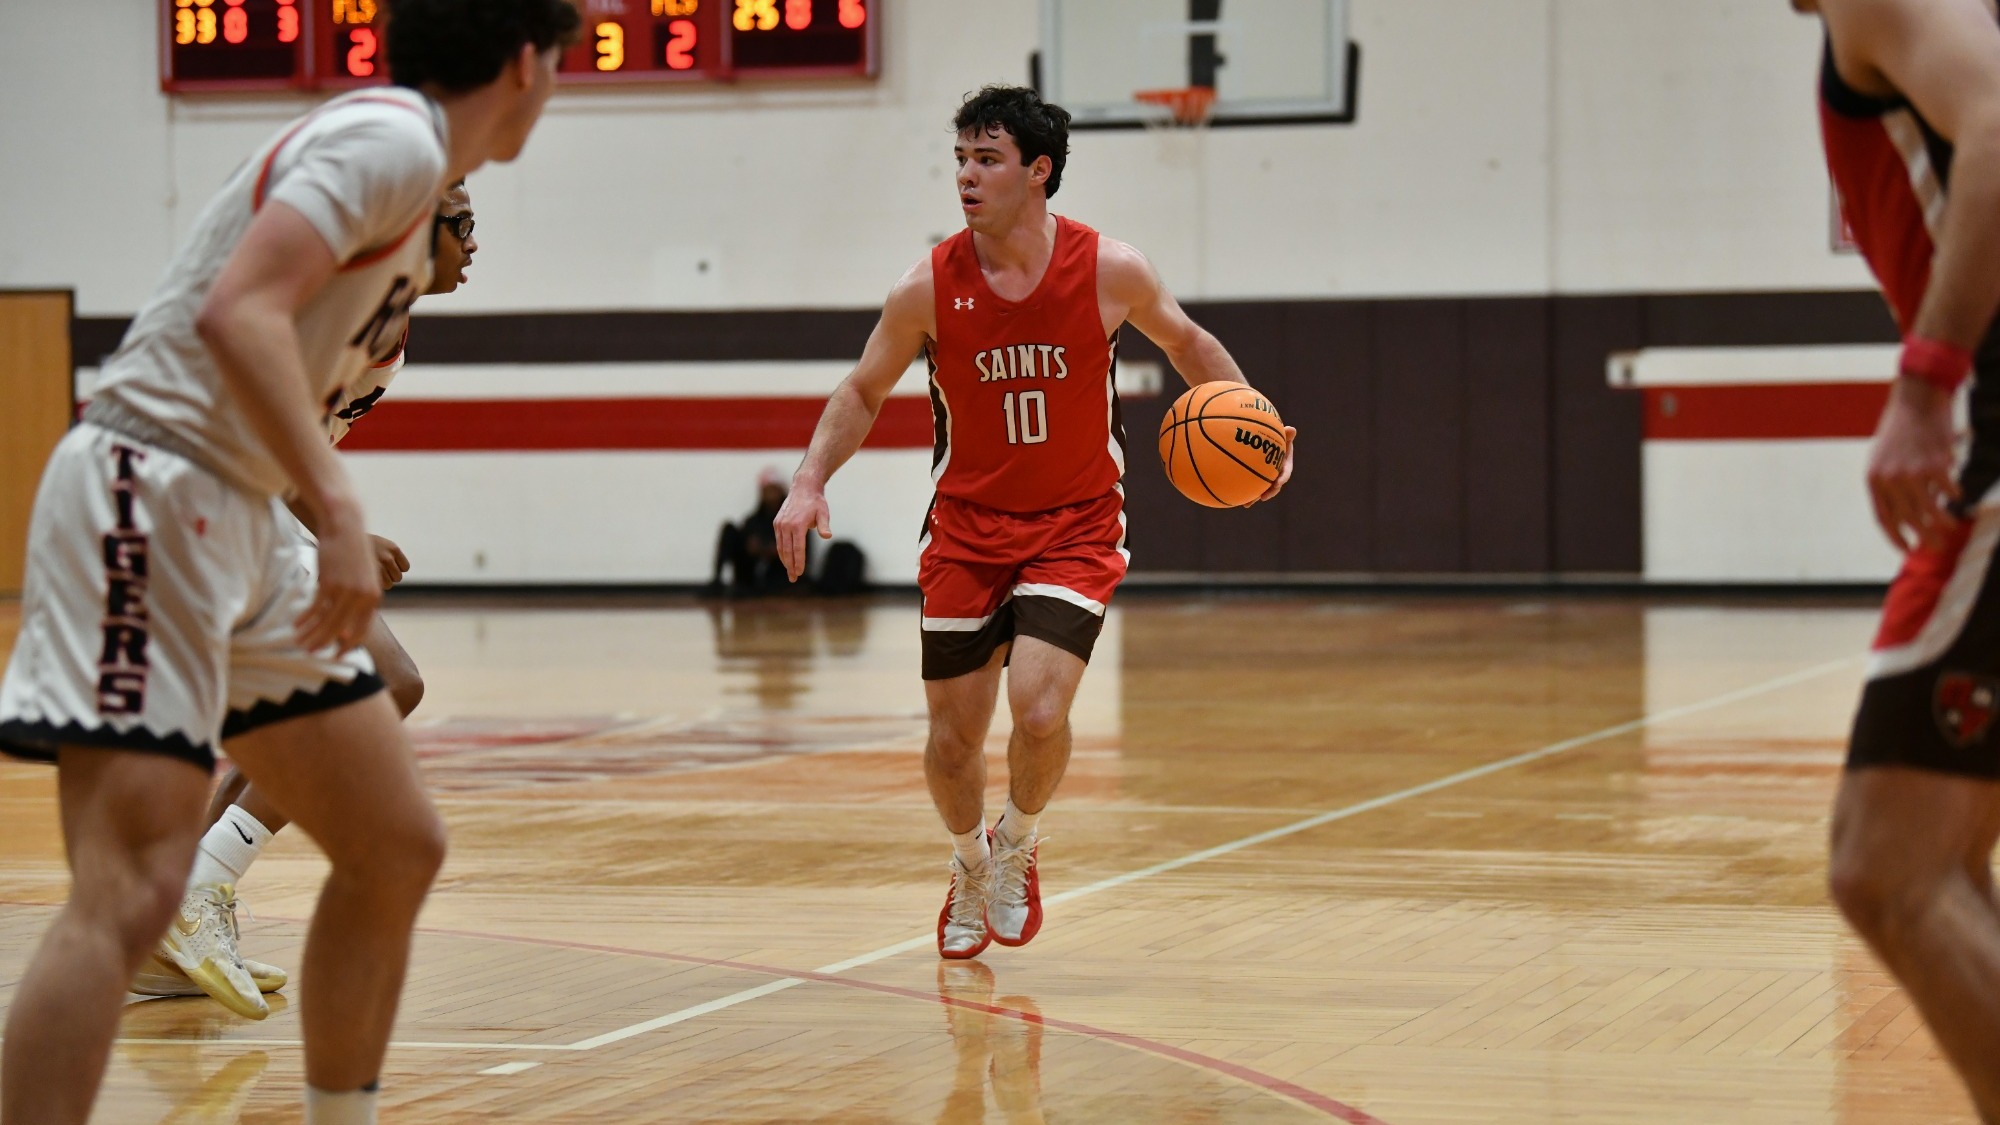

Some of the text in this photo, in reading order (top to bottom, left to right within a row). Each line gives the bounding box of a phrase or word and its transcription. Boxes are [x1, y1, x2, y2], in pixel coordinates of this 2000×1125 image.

[176, 7, 217, 44] 33
[277, 6, 299, 42] 3
[596, 22, 624, 71] 3
[666, 20, 697, 69] 2
[347, 28, 377, 76] 2
[974, 344, 1069, 382] SAINTS
[1002, 390, 1048, 444] 10
[1234, 426, 1285, 472] Wilson
[97, 444, 149, 713] TIGERS
